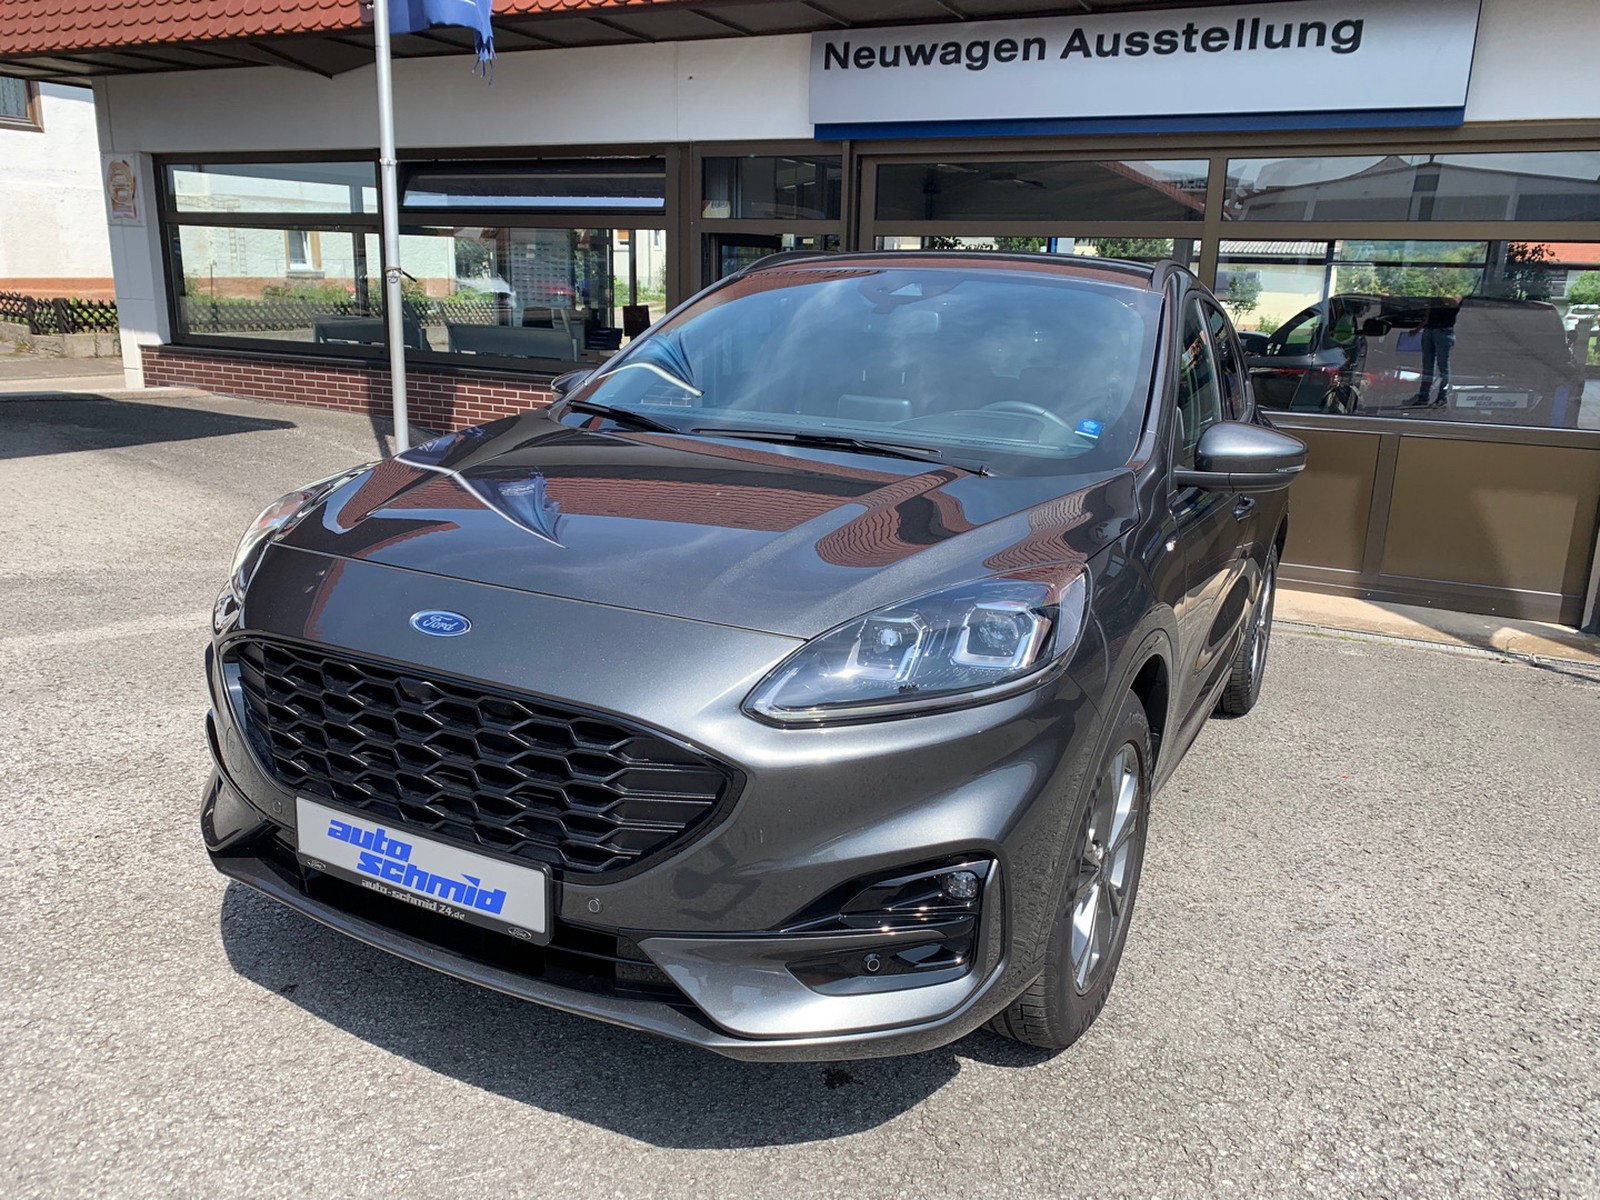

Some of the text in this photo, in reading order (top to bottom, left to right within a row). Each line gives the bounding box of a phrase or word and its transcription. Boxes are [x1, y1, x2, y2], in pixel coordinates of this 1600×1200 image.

[823, 17, 1365, 71] Neuwagen Ausstellung
[327, 819, 412, 863] auto
[356, 851, 507, 915] schmid
